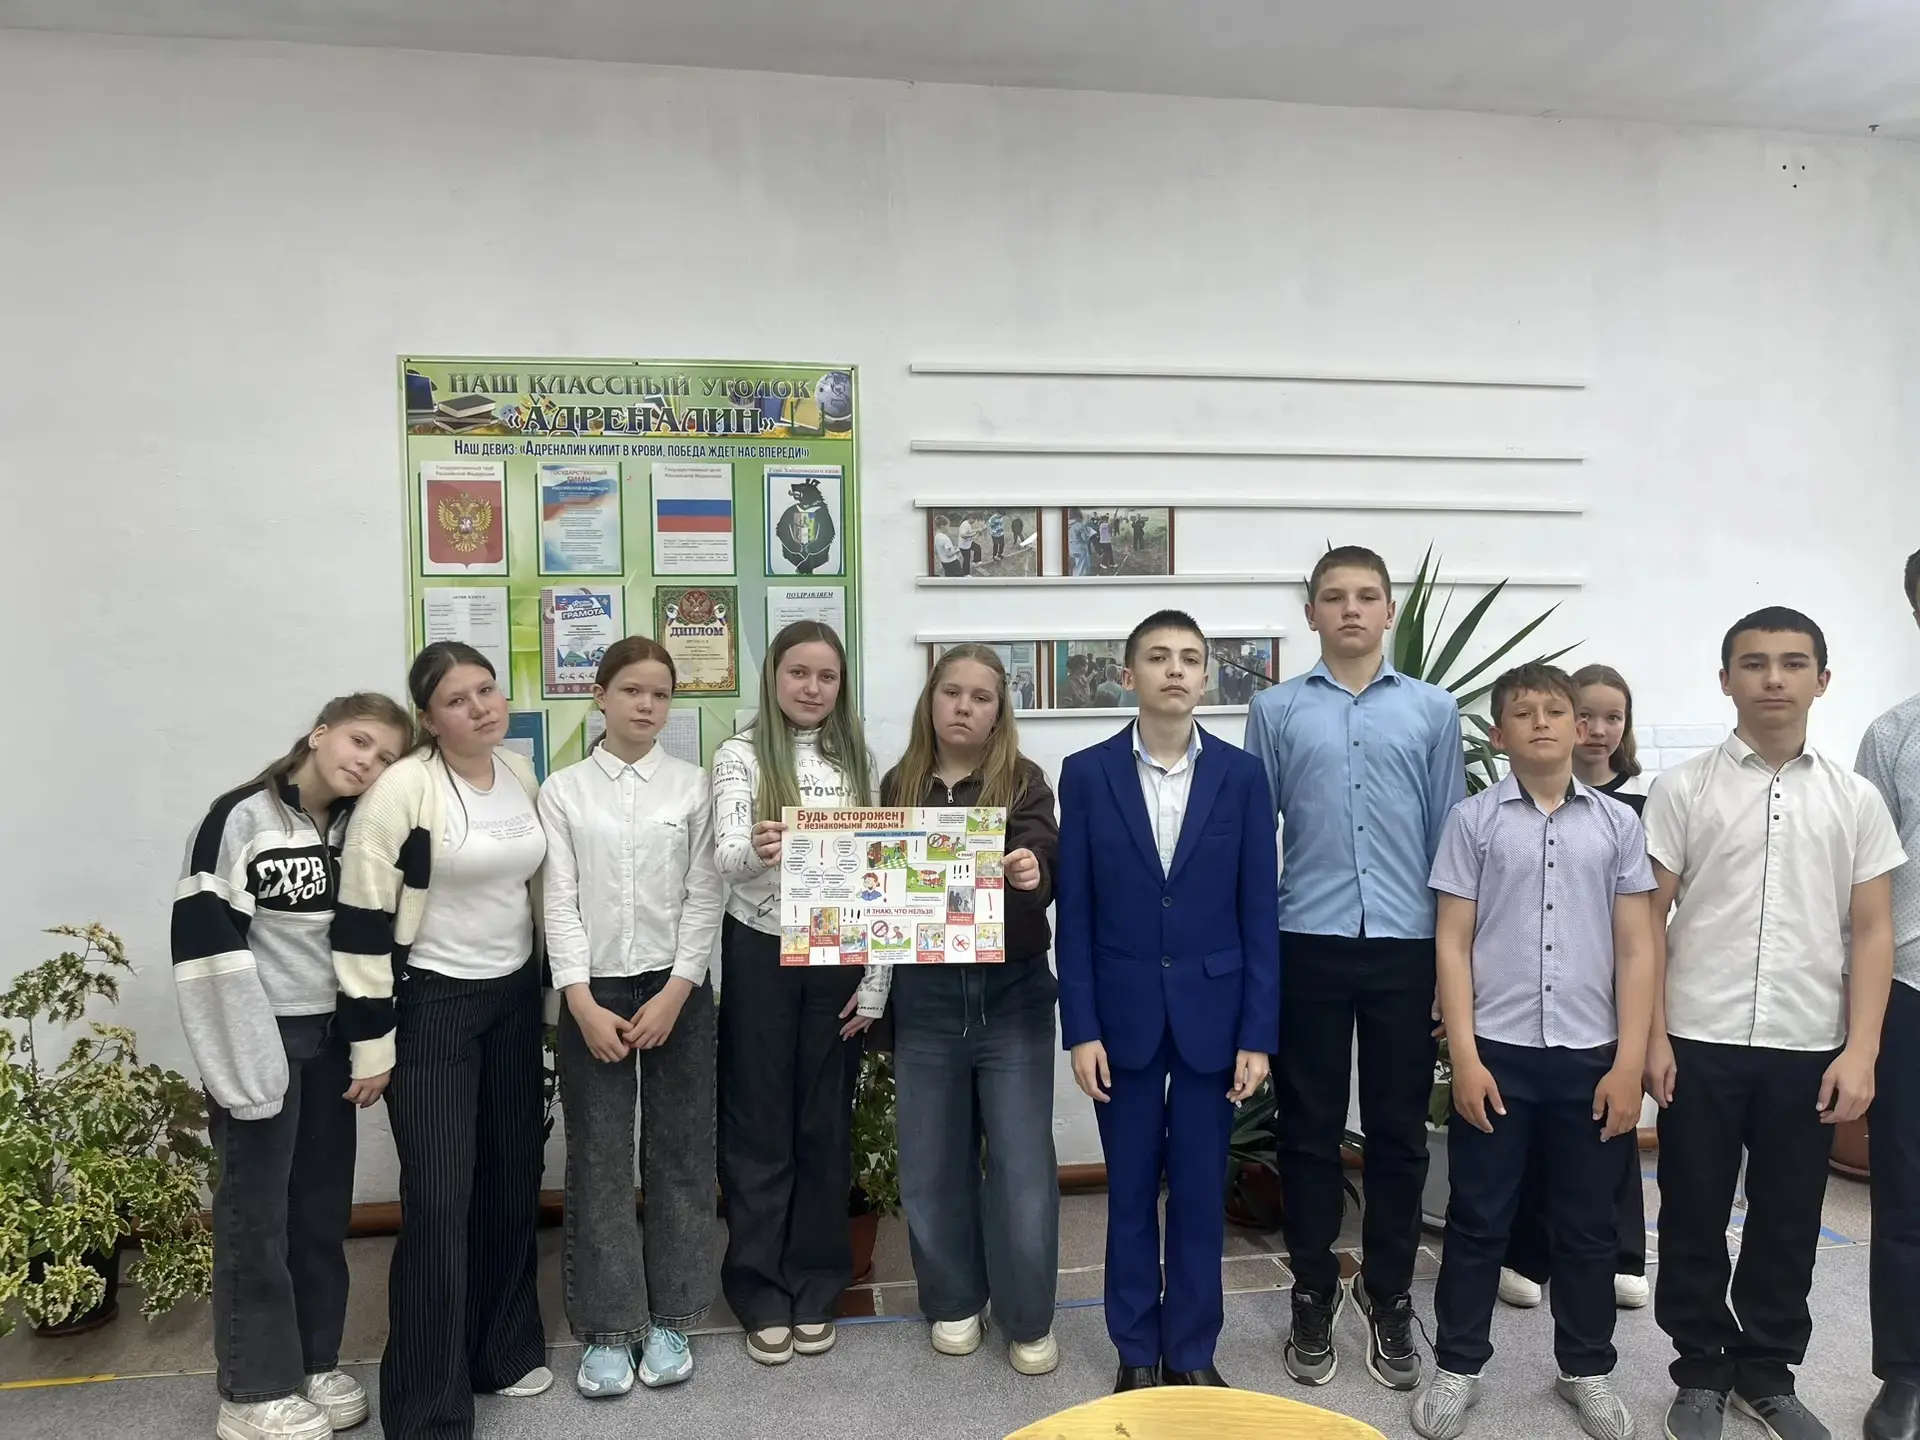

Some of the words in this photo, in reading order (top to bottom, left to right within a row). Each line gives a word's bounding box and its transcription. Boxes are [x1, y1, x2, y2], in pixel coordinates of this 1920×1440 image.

[449, 373, 518, 394] НАШ
[527, 372, 691, 396] КЛАССНЫЙ
[699, 376, 811, 399] УГОЛОК
[506, 404, 776, 438] «АДРЕНАЛИН»
[562, 608, 606, 620] ГРАМОТА
[670, 627, 724, 637] ДИПЛОМ
[797, 810, 828, 822] Будь
[804, 821, 862, 829] незнакомыми
[256, 856, 327, 900] EXPR
[287, 877, 327, 906] YOU
[872, 908, 893, 916] ЗНАЮ,
